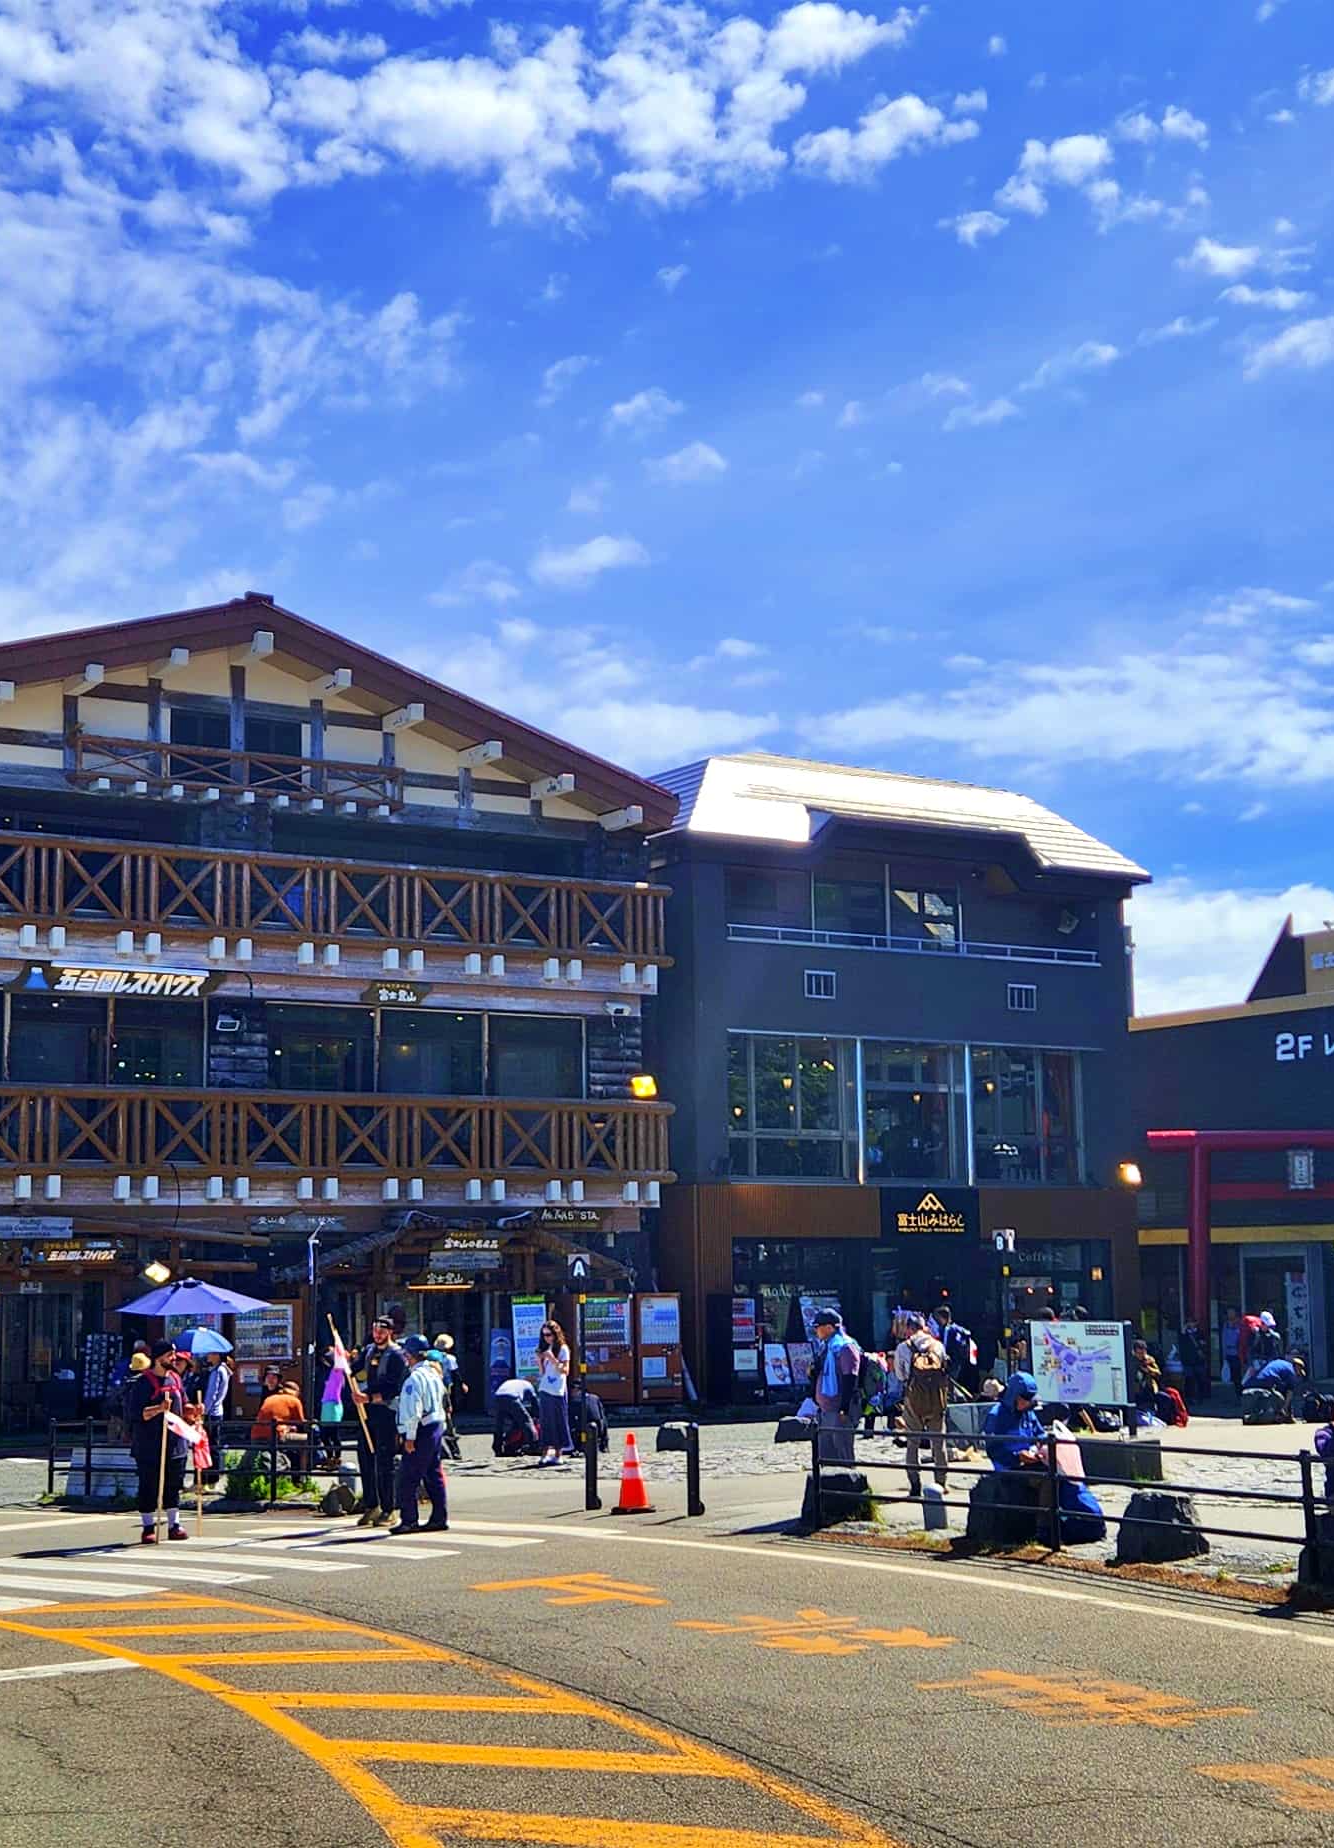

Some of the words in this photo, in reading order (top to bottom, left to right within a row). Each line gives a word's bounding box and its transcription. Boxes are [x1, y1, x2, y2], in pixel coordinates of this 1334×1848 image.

[1275, 1032, 1313, 1061] 2F
[896, 1212, 965, 1226] 富士山みはらし
[573, 1260, 586, 1277] A
